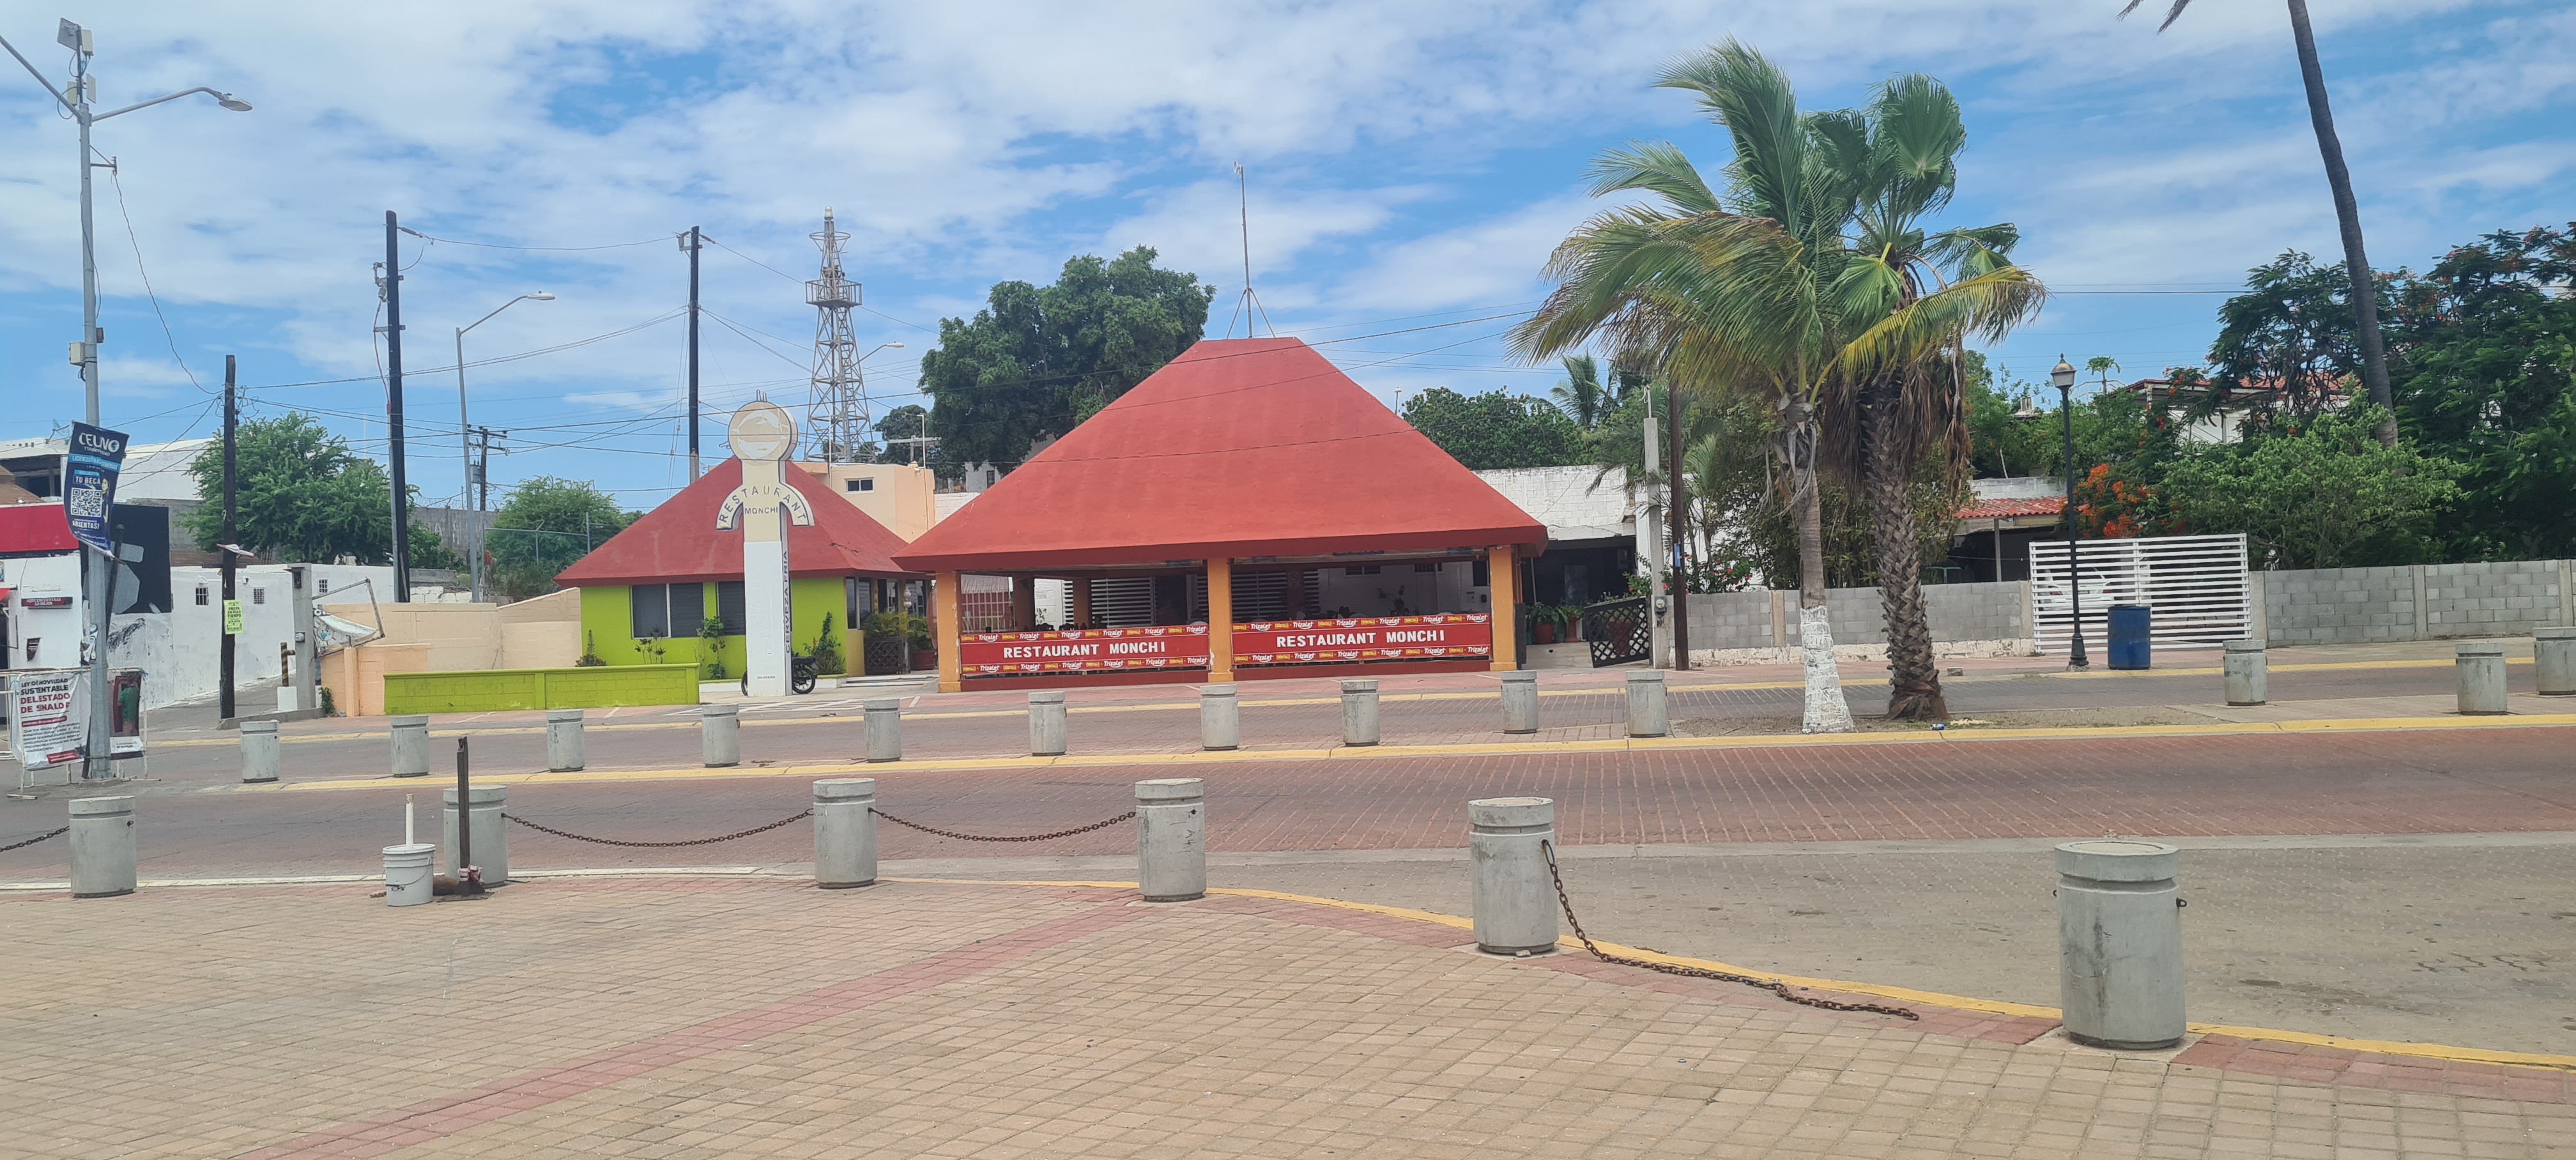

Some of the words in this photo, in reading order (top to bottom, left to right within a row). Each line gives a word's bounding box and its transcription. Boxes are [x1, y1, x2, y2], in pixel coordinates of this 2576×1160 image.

[719, 485, 806, 523] RESTAURANT
[744, 507, 778, 515] MONCHI
[1276, 632, 1376, 648] RESTAURANT
[1386, 630, 1445, 643] MONCHI
[1003, 644, 1099, 659] RESTAURANT
[1109, 641, 1165, 654] MONCHI
[20, 685, 68, 696] SUSTENTABLE
